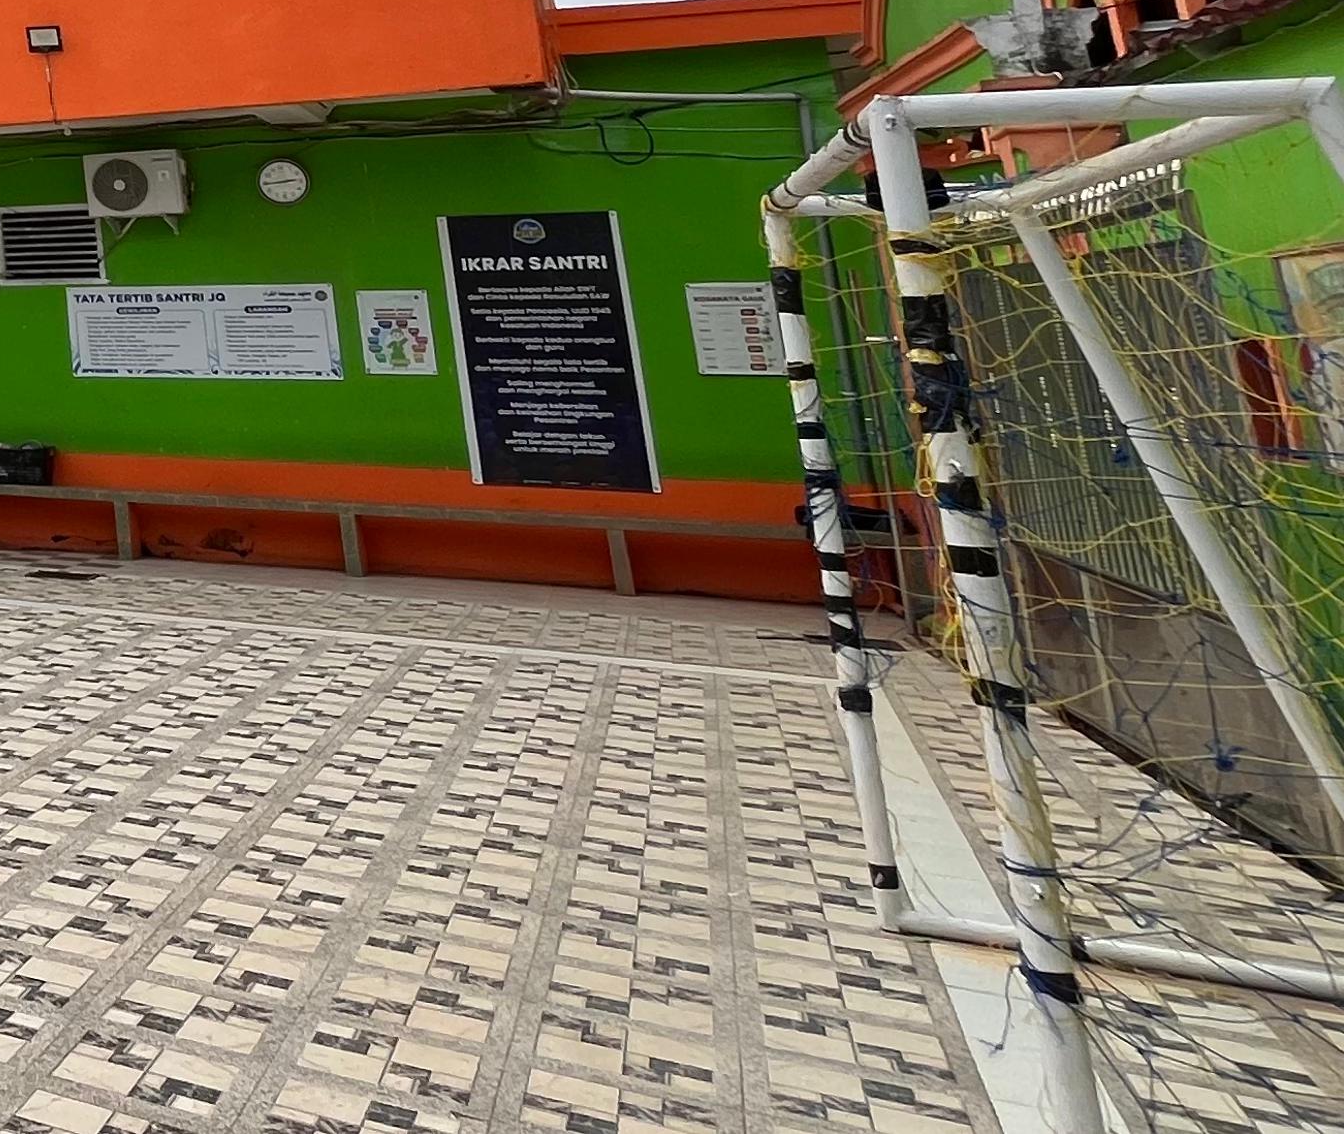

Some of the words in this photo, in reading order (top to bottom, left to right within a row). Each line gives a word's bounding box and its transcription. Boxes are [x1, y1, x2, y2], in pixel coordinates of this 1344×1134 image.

[461, 257, 524, 271] IKRAR
[528, 255, 608, 270] SANTRI
[74, 294, 105, 304] TATA
[108, 293, 153, 303] TERTIB
[156, 293, 204, 303] SANTRI
[208, 292, 226, 302] JQ
